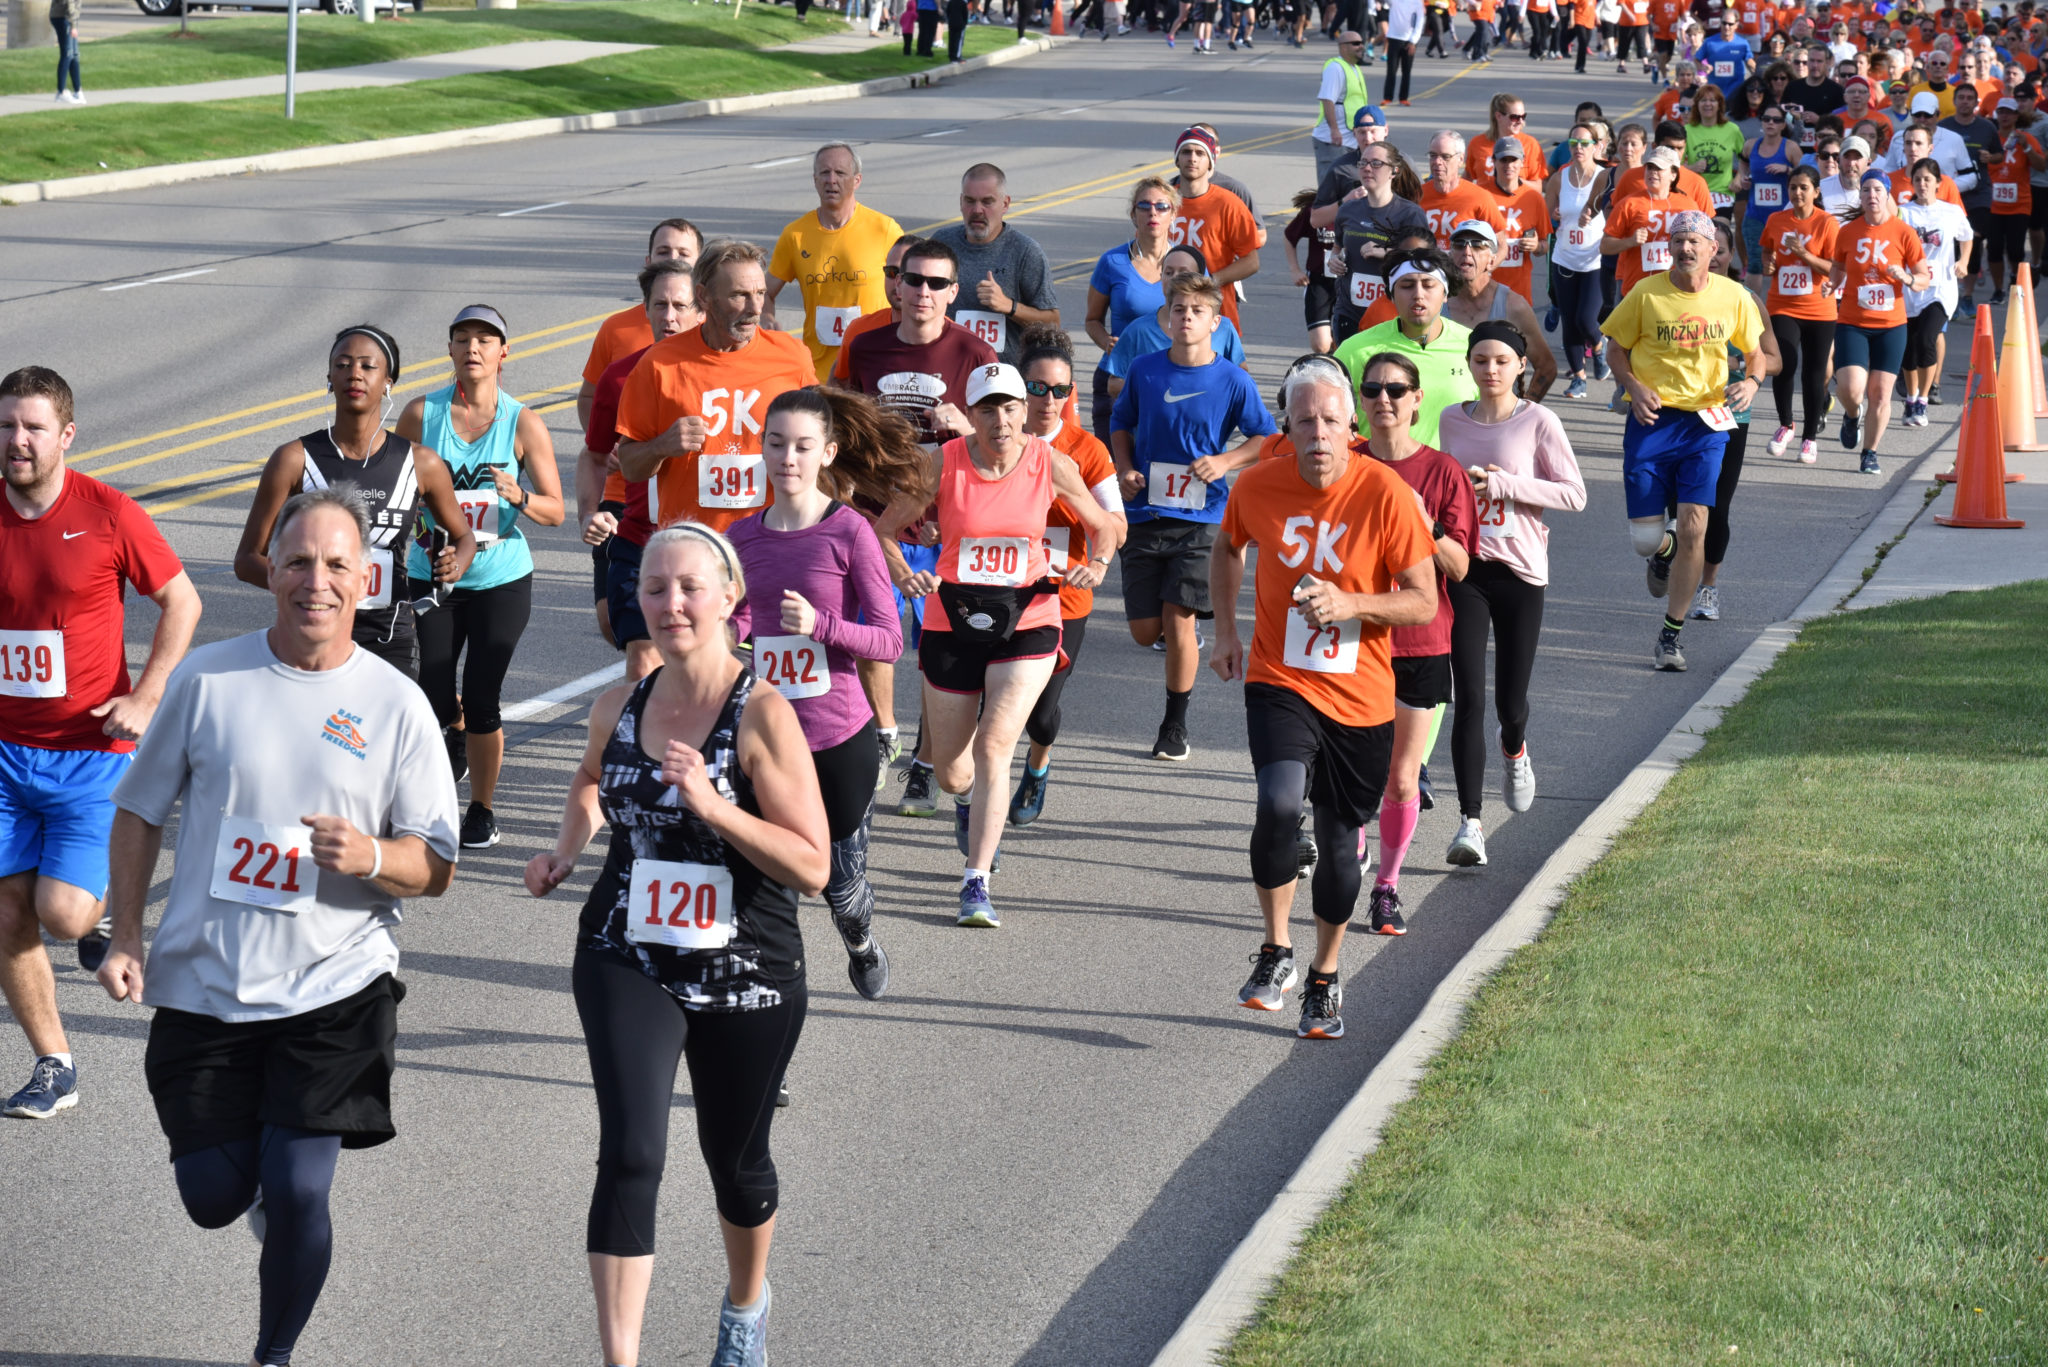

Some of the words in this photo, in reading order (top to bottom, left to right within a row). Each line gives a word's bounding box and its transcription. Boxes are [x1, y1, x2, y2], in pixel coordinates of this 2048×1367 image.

[1717, 64, 1732, 75] 258
[1671, 104, 1681, 119] 5
[1485, 156, 1495, 177] 5
[2005, 149, 2017, 164] K
[1759, 188, 1778, 201] 185
[1996, 188, 2014, 199] 396
[1168, 216, 1205, 248] 5K
[1426, 209, 1458, 236] 5K
[1569, 230, 1584, 245] 50
[1646, 250, 1673, 264] 415
[1855, 238, 1890, 265] 5K
[806, 266, 867, 287] parkrun
[1783, 272, 1807, 289] 228
[1356, 281, 1386, 301] 356
[1868, 290, 1885, 305] 38
[832, 316, 844, 337] 4
[963, 319, 1000, 344] 165
[1703, 323, 1725, 341] RUN
[883, 383, 920, 392] EMBRACE
[895, 395, 935, 405] ANNIVERSARY
[702, 387, 761, 437] 5K
[709, 466, 757, 497] 391
[1165, 473, 1192, 499] 17
[352, 488, 386, 500] iselle
[1277, 515, 1348, 574] 5K
[969, 545, 1019, 575] 390
[1304, 624, 1341, 660] 73
[0, 644, 53, 683] 139
[763, 648, 818, 686] 242
[337, 708, 363, 726] RACE
[320, 731, 366, 761] FREEDOM
[228, 837, 300, 893] 221
[645, 879, 717, 930] 120
